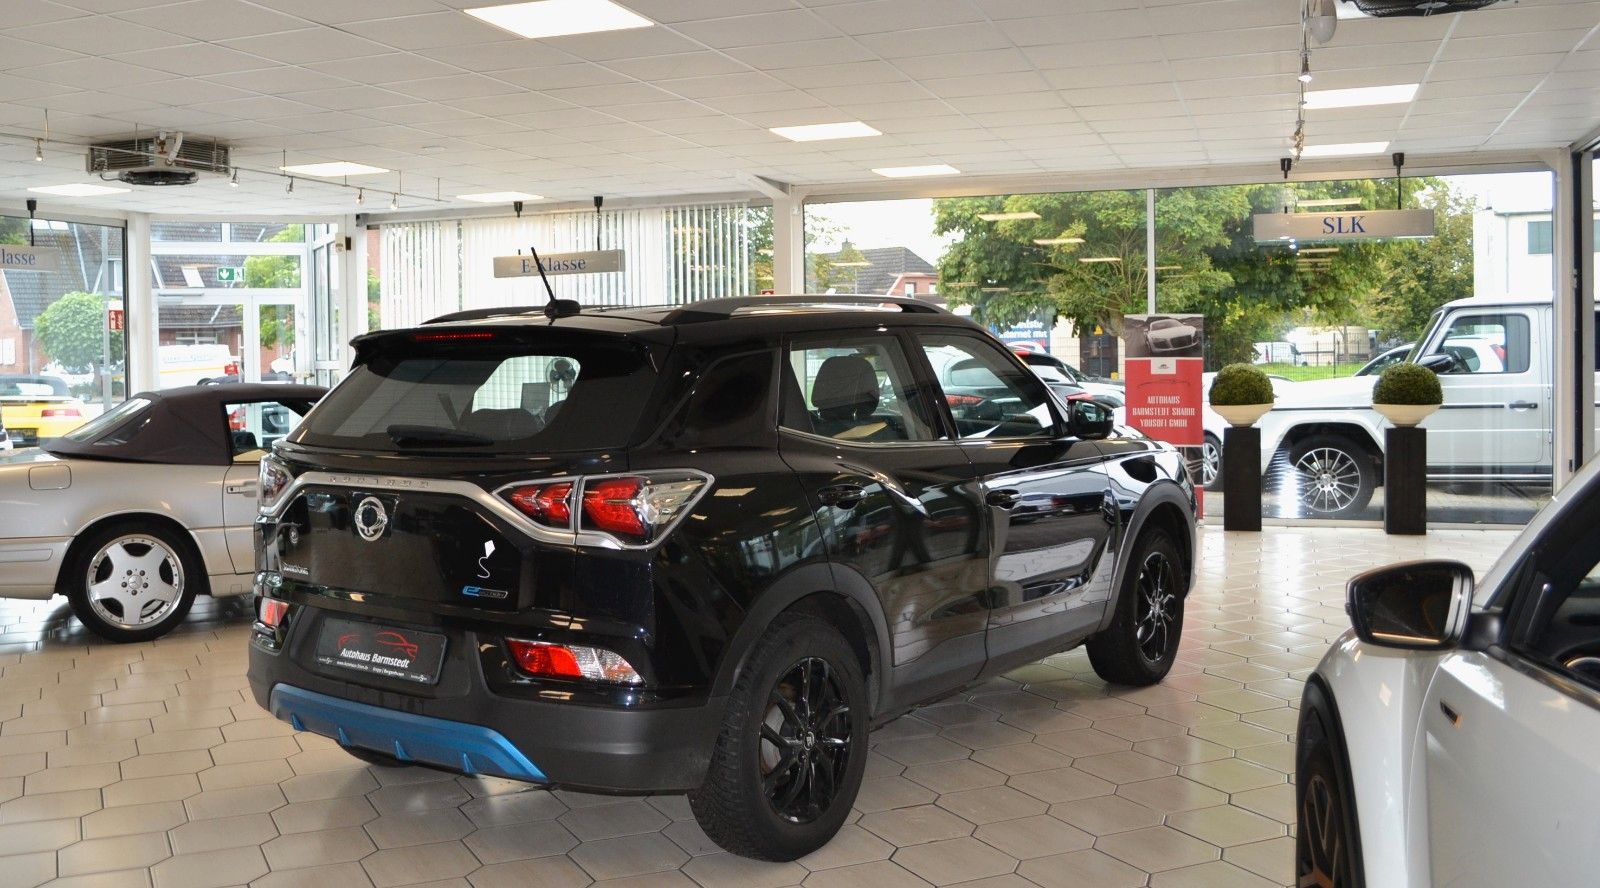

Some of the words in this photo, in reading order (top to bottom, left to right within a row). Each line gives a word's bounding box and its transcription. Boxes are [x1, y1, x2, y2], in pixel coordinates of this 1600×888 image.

[1322, 215, 1366, 234] SLK
[521, 257, 587, 273] E-Klasse
[1147, 396, 1180, 404] AUTOHAUS
[1132, 407, 1170, 416] BARMSTEDT
[340, 648, 371, 662] Autohaus
[371, 653, 410, 668] Barmstedt
